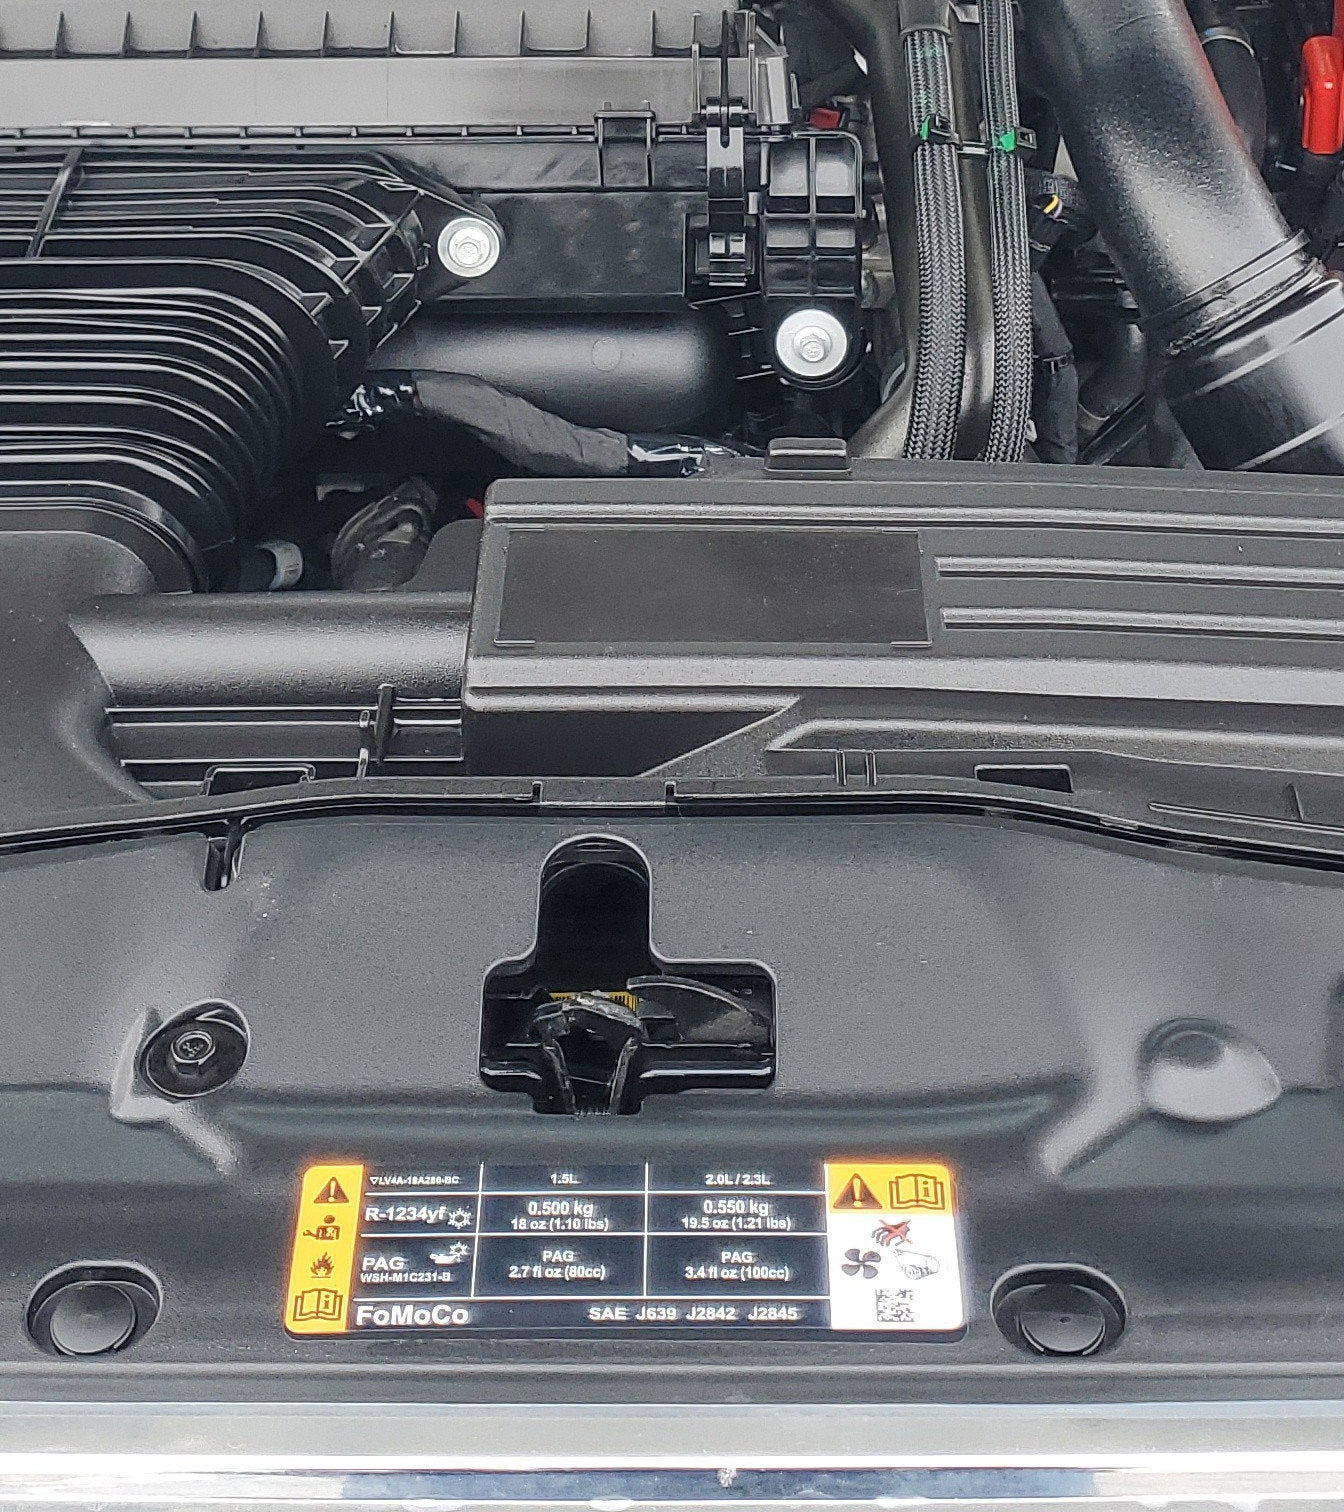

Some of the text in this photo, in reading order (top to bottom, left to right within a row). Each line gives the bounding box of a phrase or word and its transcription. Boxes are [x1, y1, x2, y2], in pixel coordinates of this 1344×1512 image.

[550, 1173, 578, 1184] 1.5L
[705, 1173, 734, 1185] 2.0L
[742, 1173, 771, 1185] 2.3L
[364, 1206, 447, 1224] R-1234yf
[527, 1199, 594, 1217] 0.500 kg
[703, 1199, 769, 1216] 0.550 kg
[511, 1217, 609, 1231] 18 oz (1.10 lbs)
[681, 1216, 791, 1231] 19.5 oz (1.21 lbs)
[362, 1256, 405, 1271] PAG
[542, 1250, 574, 1262] PAG
[721, 1251, 753, 1263] PAG
[360, 1271, 451, 1283] WSH-M1C231-B
[508, 1264, 606, 1281] 2.7 fl oz (80cc)
[684, 1265, 789, 1281] 3.4 fl oz (100cc)
[356, 1304, 469, 1326] FoMoCo
[588, 1306, 798, 1320] SAE J639 J2842 J2845
